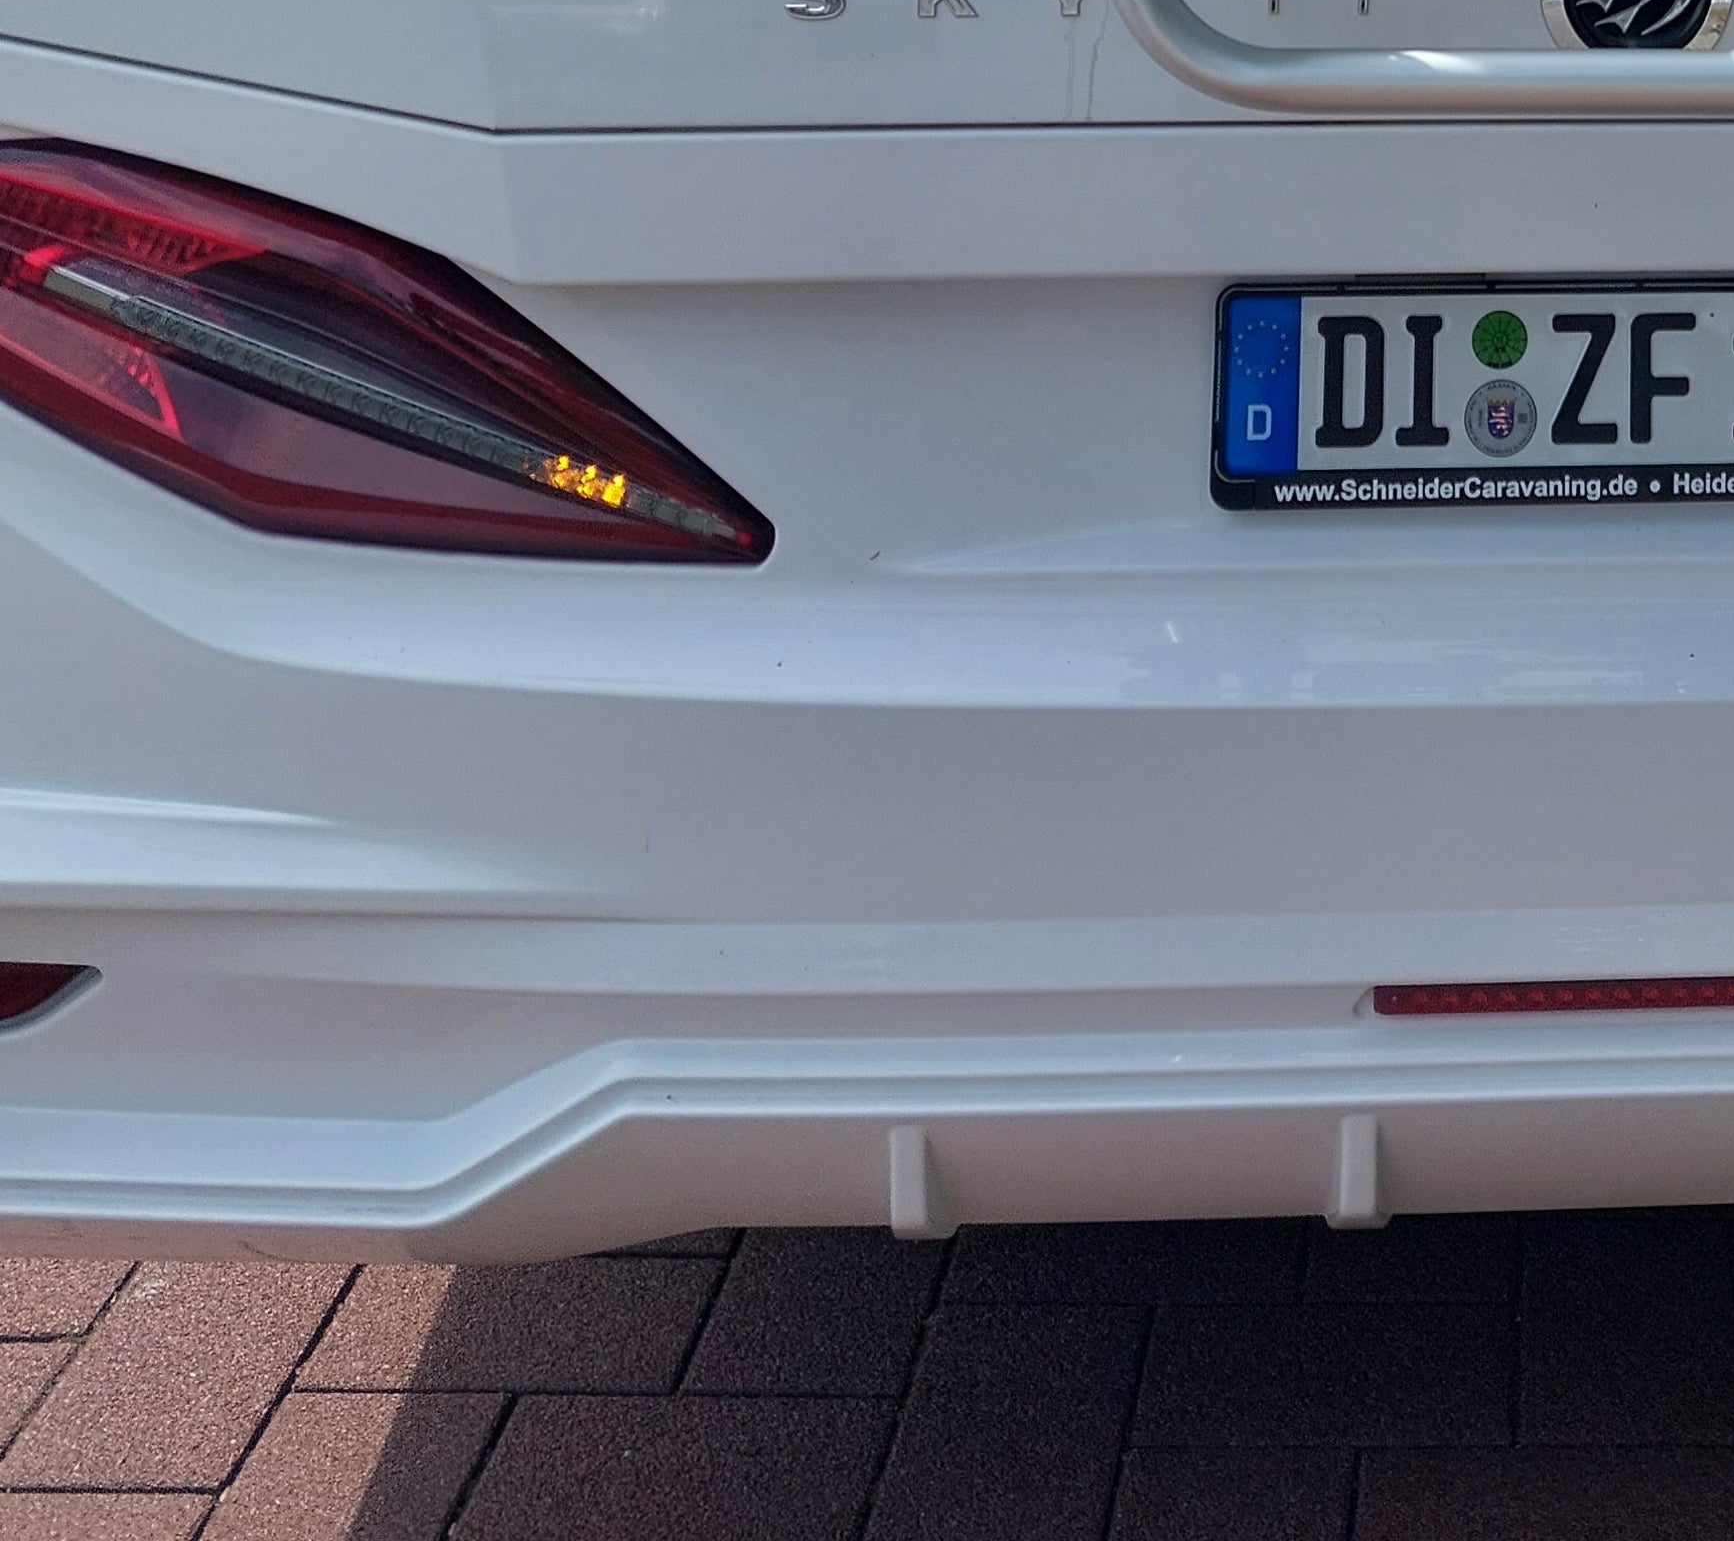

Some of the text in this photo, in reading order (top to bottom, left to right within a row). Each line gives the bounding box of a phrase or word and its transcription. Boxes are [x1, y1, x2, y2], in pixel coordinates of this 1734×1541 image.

[1315, 315, 1450, 449] DI
[1551, 311, 1697, 445] ZF
[1246, 403, 1273, 442] D
[1273, 474, 1639, 503] www.SchneiderCaravaning.de
